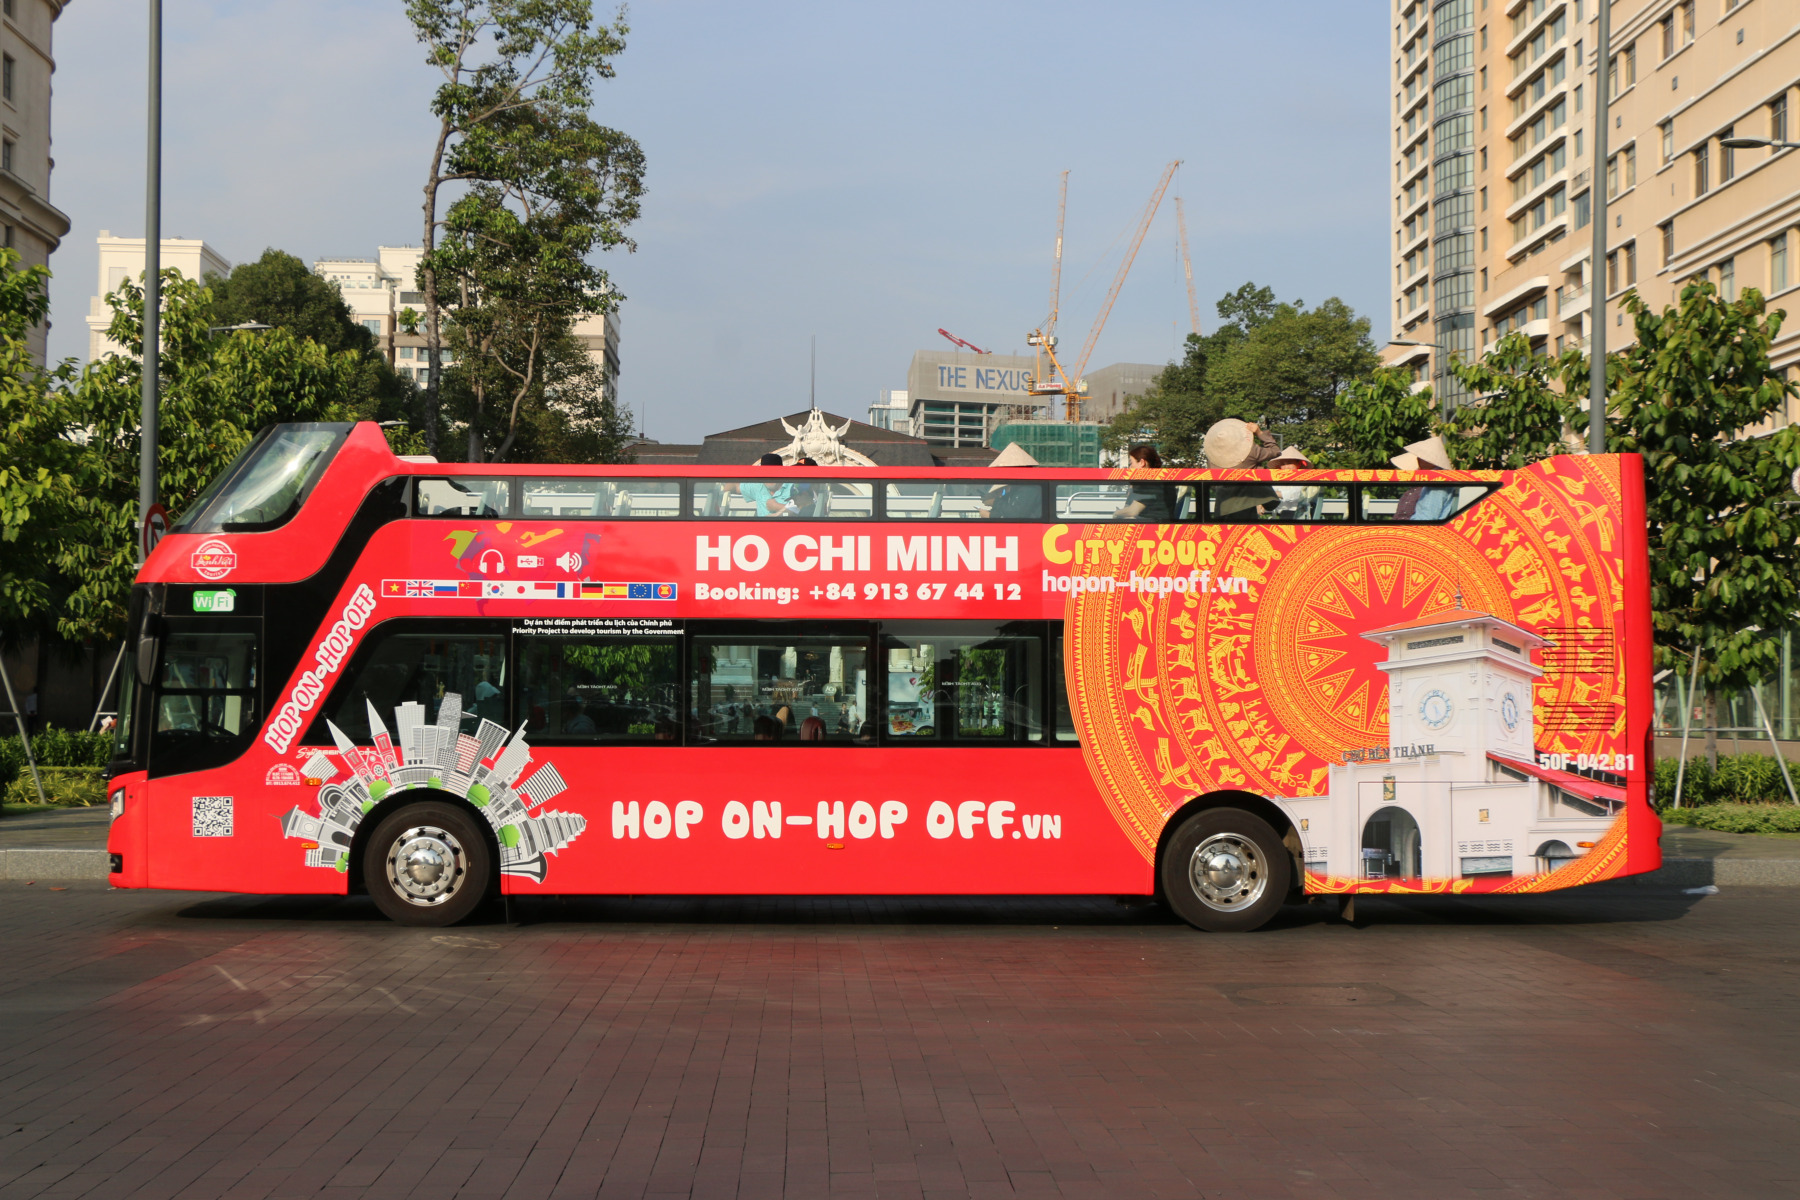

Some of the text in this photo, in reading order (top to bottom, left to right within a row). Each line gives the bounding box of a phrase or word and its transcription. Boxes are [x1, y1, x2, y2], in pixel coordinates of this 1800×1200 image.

[938, 366, 1031, 392] THE NEXUS
[696, 534, 1018, 571] HO CHI MINH
[1042, 524, 1216, 565] CITY TOUR
[695, 582, 1021, 604] Booking: +84 913 67 44 12
[1042, 569, 1248, 599] hopon-hopoff.vn
[512, 627, 536, 635] Priority
[537, 627, 560, 635] Project
[570, 627, 595, 635] develop
[264, 702, 302, 754] HOP
[343, 583, 376, 630] OFF
[1393, 743, 1434, 758] THÀNH
[1539, 753, 1634, 770] 50F-042.81
[611, 800, 1062, 839] HOP ON-HOP OFF.VN
